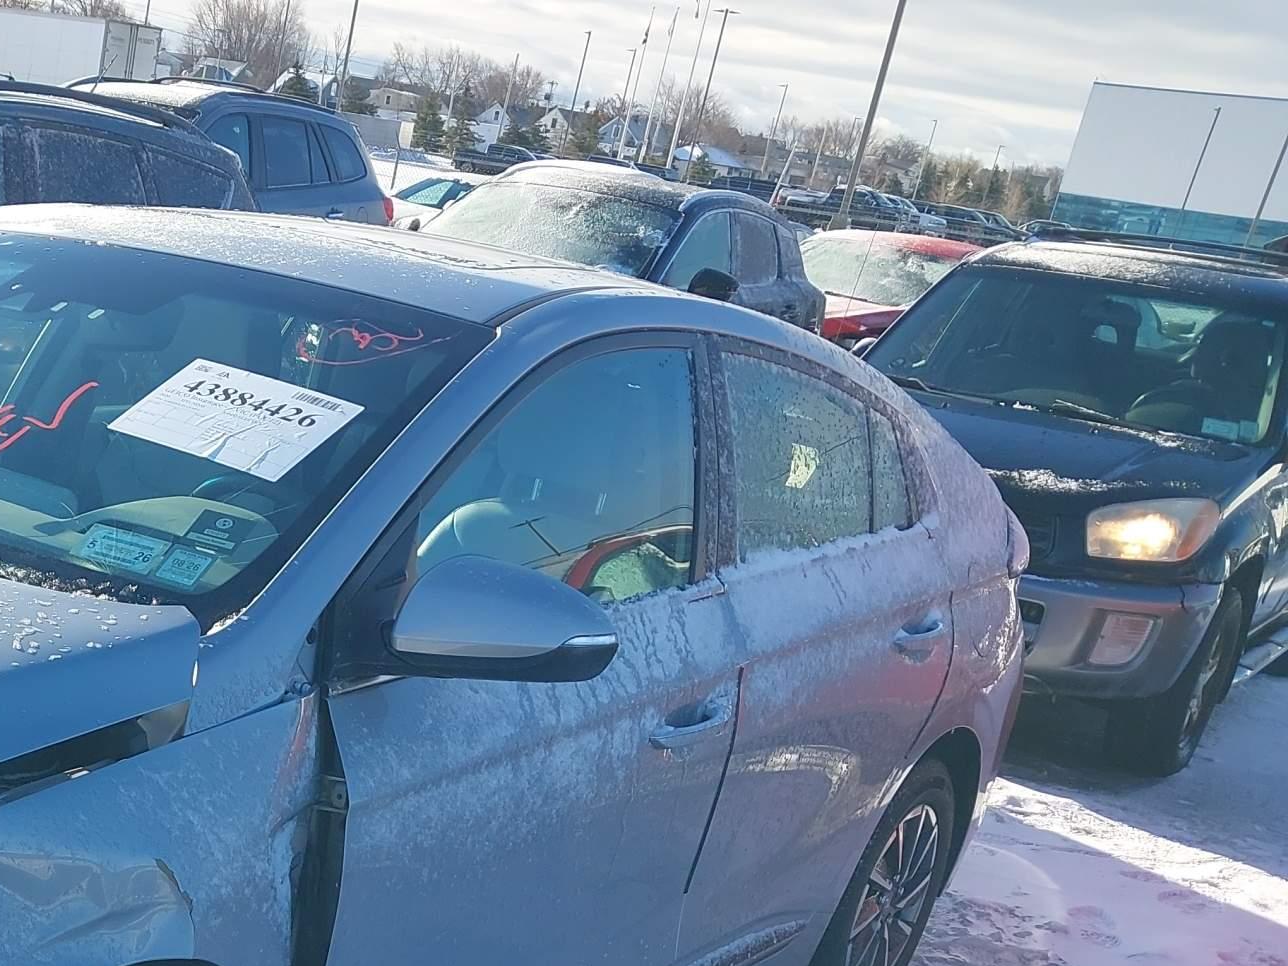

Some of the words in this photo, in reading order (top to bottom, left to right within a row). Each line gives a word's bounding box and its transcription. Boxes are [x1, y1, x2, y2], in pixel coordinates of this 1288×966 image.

[184, 379, 318, 428] 43884426
[87, 540, 98, 549] 5
[134, 551, 153, 563] 26
[172, 558, 186, 568] 08
[186, 560, 201, 572] 26
